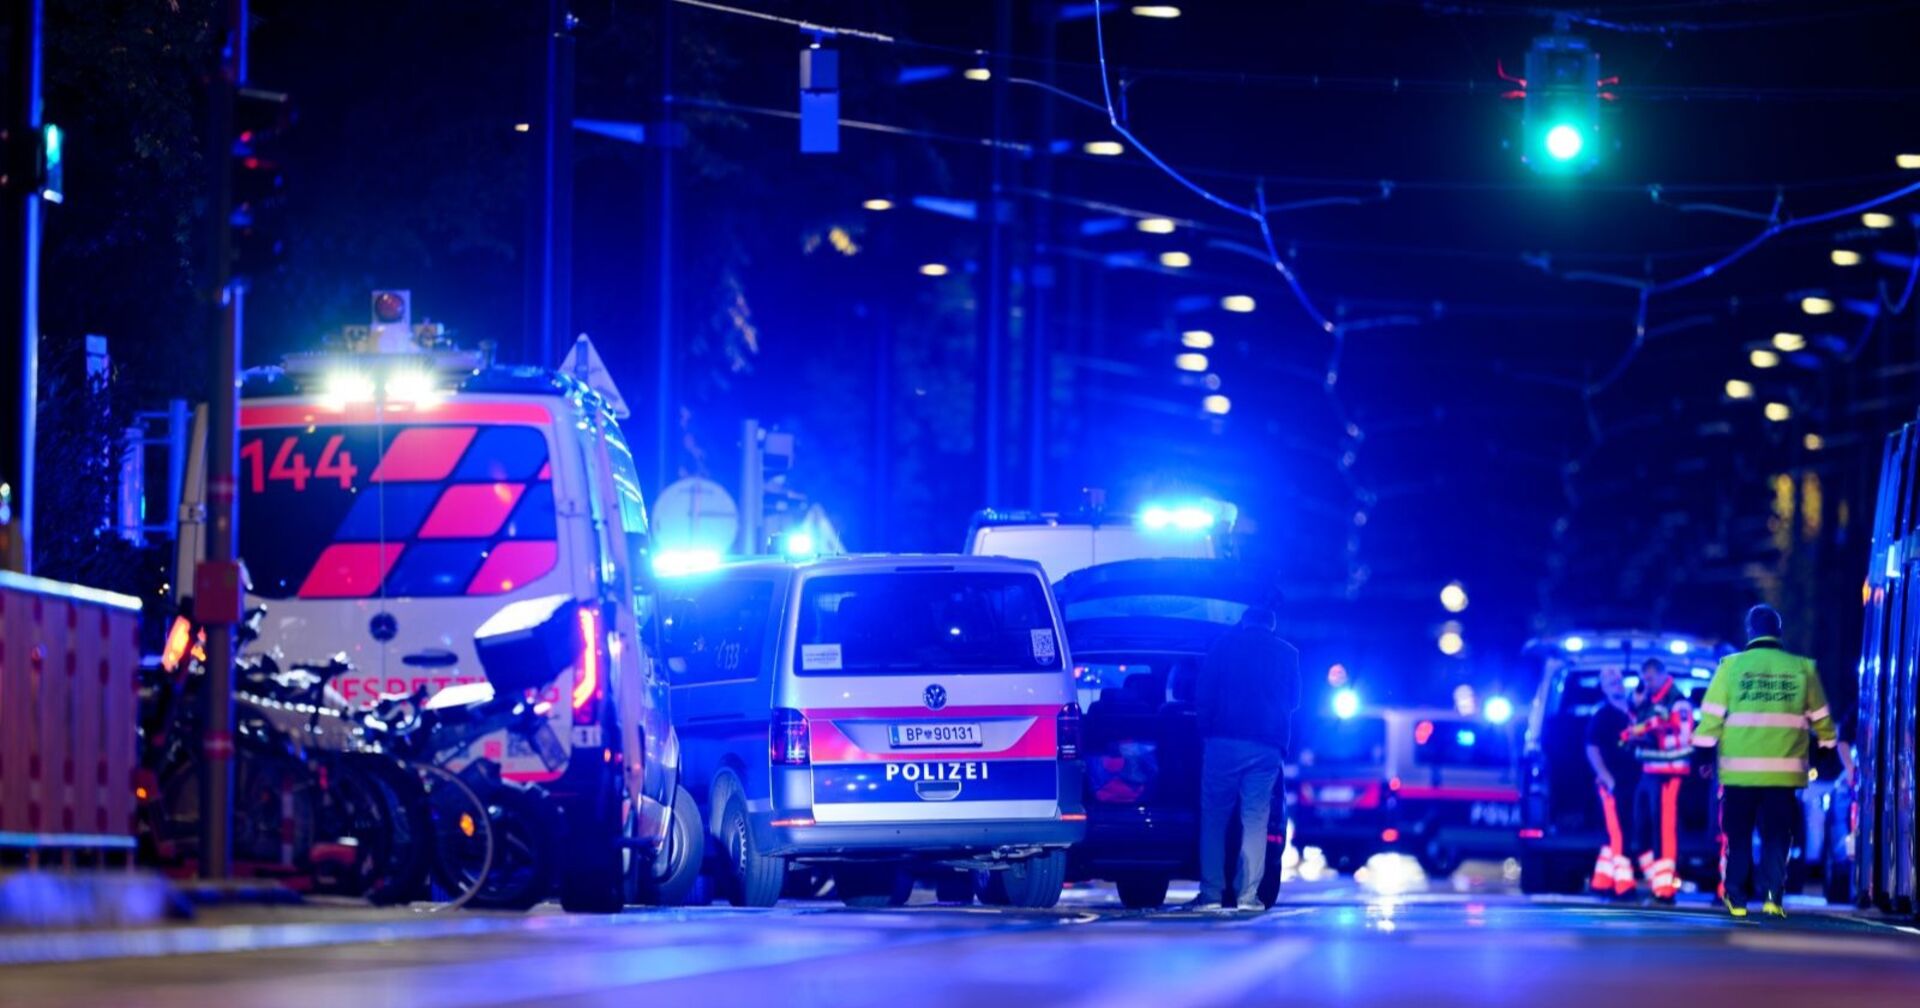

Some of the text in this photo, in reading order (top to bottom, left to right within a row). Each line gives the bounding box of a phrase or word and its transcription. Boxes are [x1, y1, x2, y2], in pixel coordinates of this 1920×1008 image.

[240, 435, 358, 493] 144
[906, 726, 973, 741] BP 90131
[886, 762, 988, 781] POLIZEI
